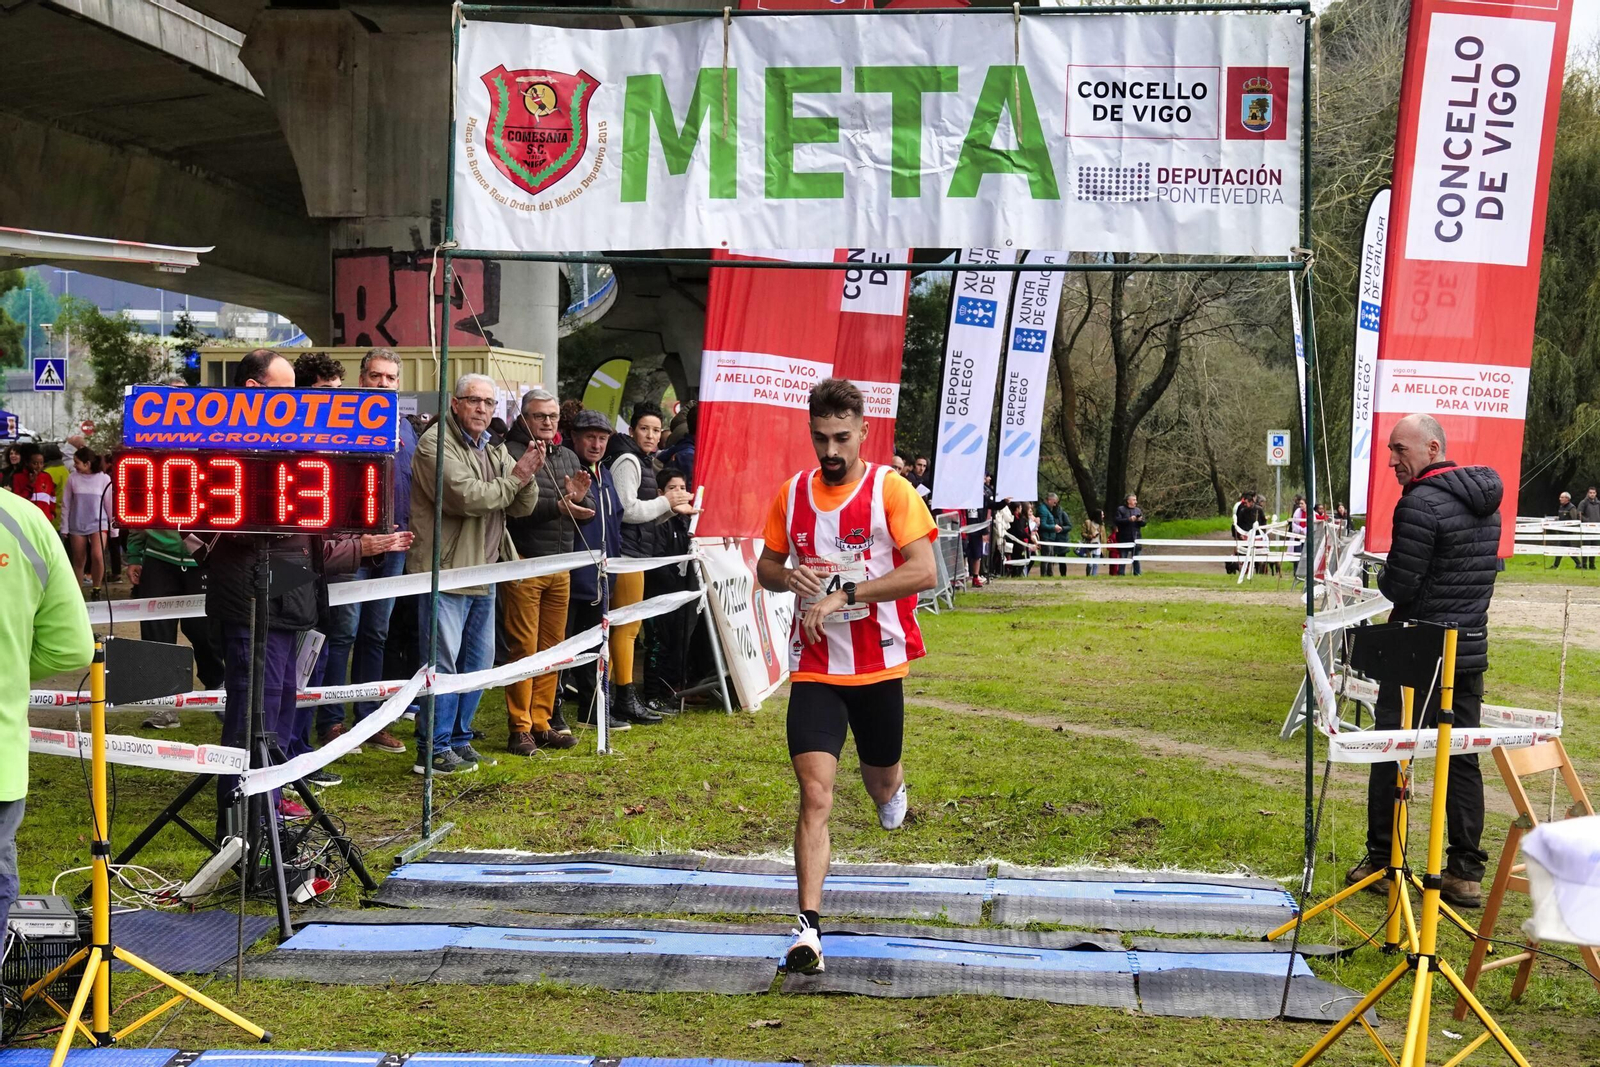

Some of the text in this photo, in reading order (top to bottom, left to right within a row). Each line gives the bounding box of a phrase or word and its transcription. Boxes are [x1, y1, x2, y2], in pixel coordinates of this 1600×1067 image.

[1077, 81, 1208, 100] CONCELLO
[1092, 104, 1192, 123] DE VIGO
[619, 65, 1061, 203] META
[1434, 35, 1485, 243] CONCELLO
[1475, 63, 1521, 221] DE VIGO
[526, 144, 547, 155] S.C.
[465, 116, 607, 212] Placa de Bronce Real Orden del Mérito Deportivo 2015
[1157, 163, 1282, 186] DEPUTACIÓN
[1157, 187, 1284, 205] PONTEVEDRA
[1373, 216, 1386, 277] GALICIA
[1363, 243, 1374, 297] XUNTA
[980, 275, 996, 295] DE
[1019, 280, 1036, 324] XUNTA
[1032, 309, 1045, 326] DE
[714, 373, 722, 383] A
[723, 373, 772, 386] MELLOR
[946, 349, 963, 415] DEPORTE
[958, 358, 974, 416] GALEGO
[753, 388, 779, 401] PARA
[1006, 371, 1020, 425] DEPORTE
[1361, 363, 1371, 421] GALEGO
[1391, 383, 1510, 399] A MELLOR CIDADE
[132, 391, 391, 430] CRONOTEC
[868, 406, 891, 415] VIVIR
[1016, 378, 1029, 426] GALEGO
[1435, 398, 1509, 413] PARA VIVIR
[134, 431, 389, 447] WWW.CRONOTEC.ES
[34, 694, 54, 704] VIGO
[157, 696, 175, 706] VIGO
[324, 690, 355, 700] CONCELLO
[355, 689, 364, 698] DE
[364, 688, 378, 697] VIGO
